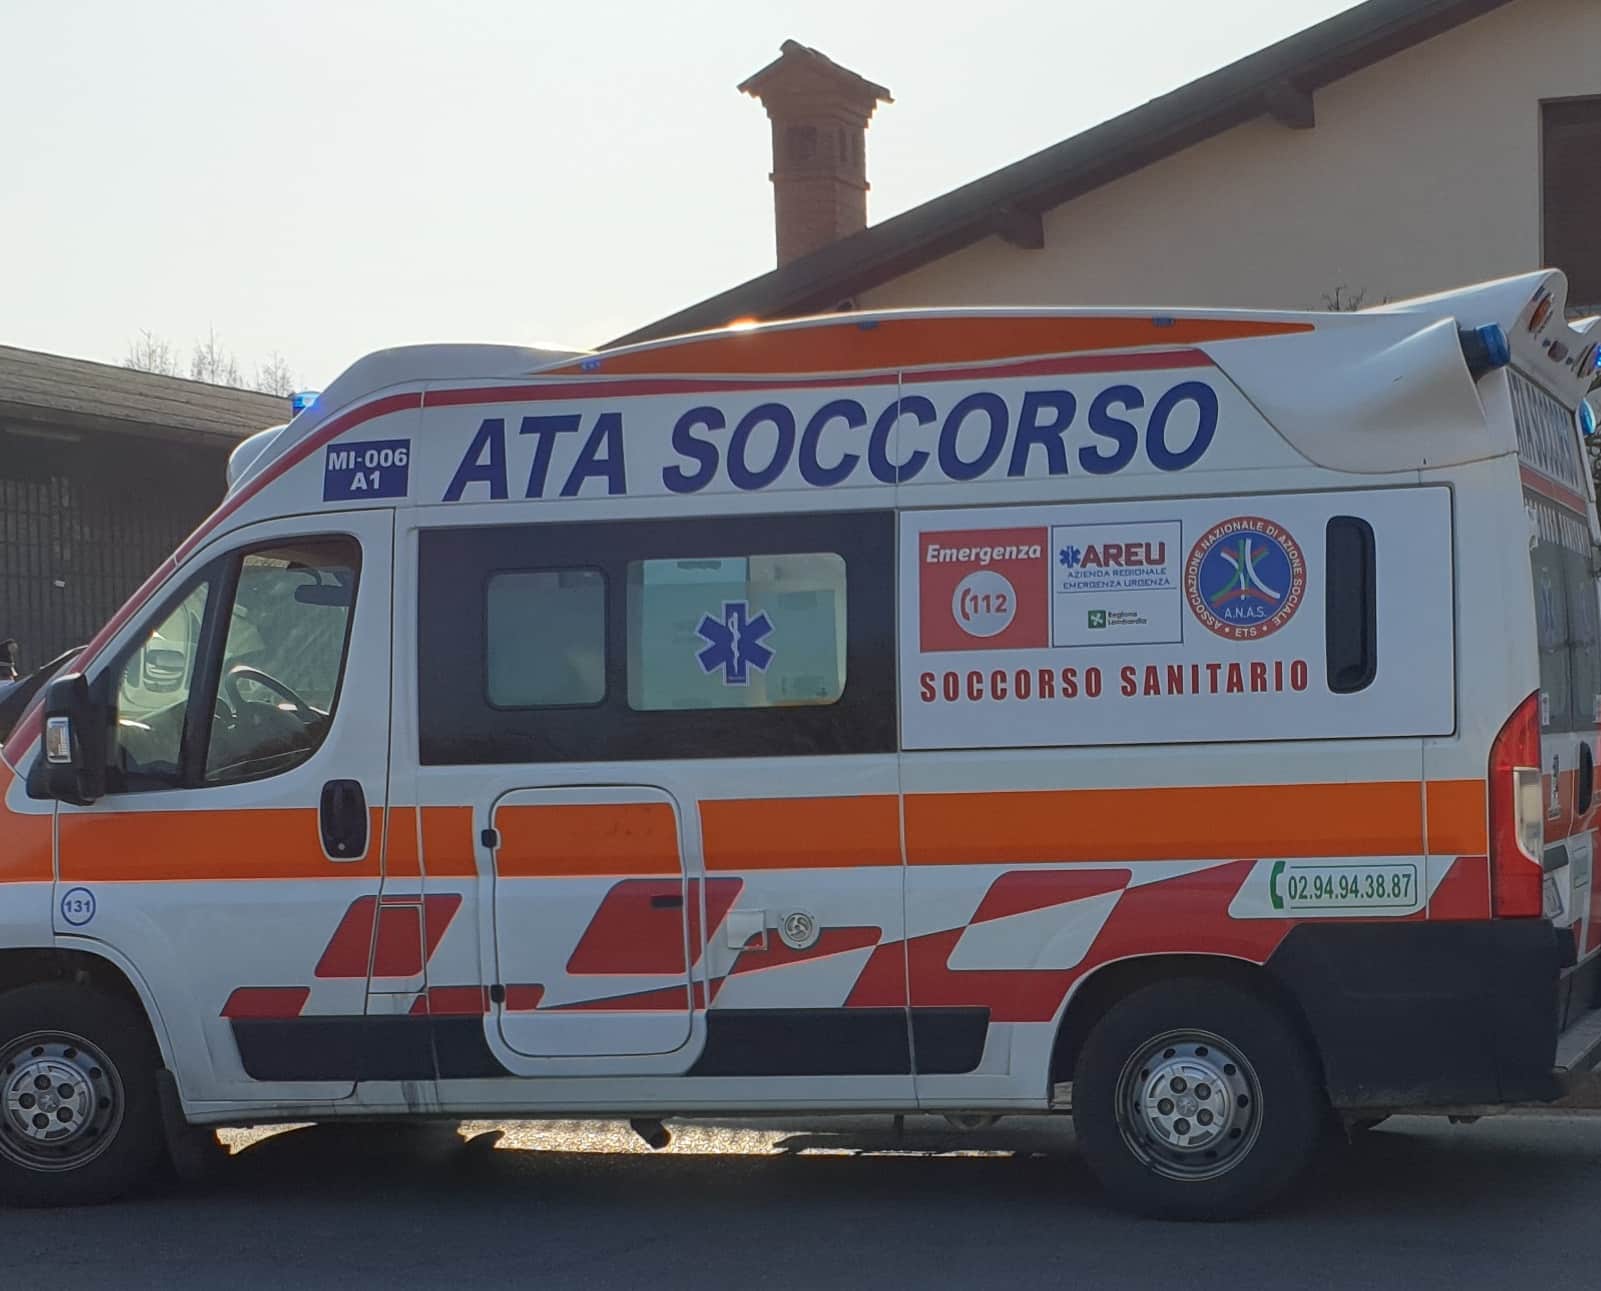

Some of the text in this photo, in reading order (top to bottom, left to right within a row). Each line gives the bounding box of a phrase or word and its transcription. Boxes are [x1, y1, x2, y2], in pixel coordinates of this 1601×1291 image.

[441, 380, 1218, 502] ATA SOCCORSO
[328, 448, 408, 470] MI-006
[349, 470, 381, 491] A1
[926, 544, 1041, 566] Emergenza
[1080, 541, 1166, 569] AREU
[1063, 577, 1170, 590] EMERGENZA URGENZA
[1067, 567, 1167, 579] AZIENDA REGIONALE
[1188, 520, 1304, 631] ASSOCIAZIONE NAZIONALE DI AZIONE SOCIALE
[970, 594, 1008, 614] 112
[1235, 627, 1257, 638] ETS
[920, 660, 1308, 702] SOCCORSO SANITARIO
[1288, 874, 1412, 900] 02.94.94.38.87
[65, 899, 91, 913] 131
